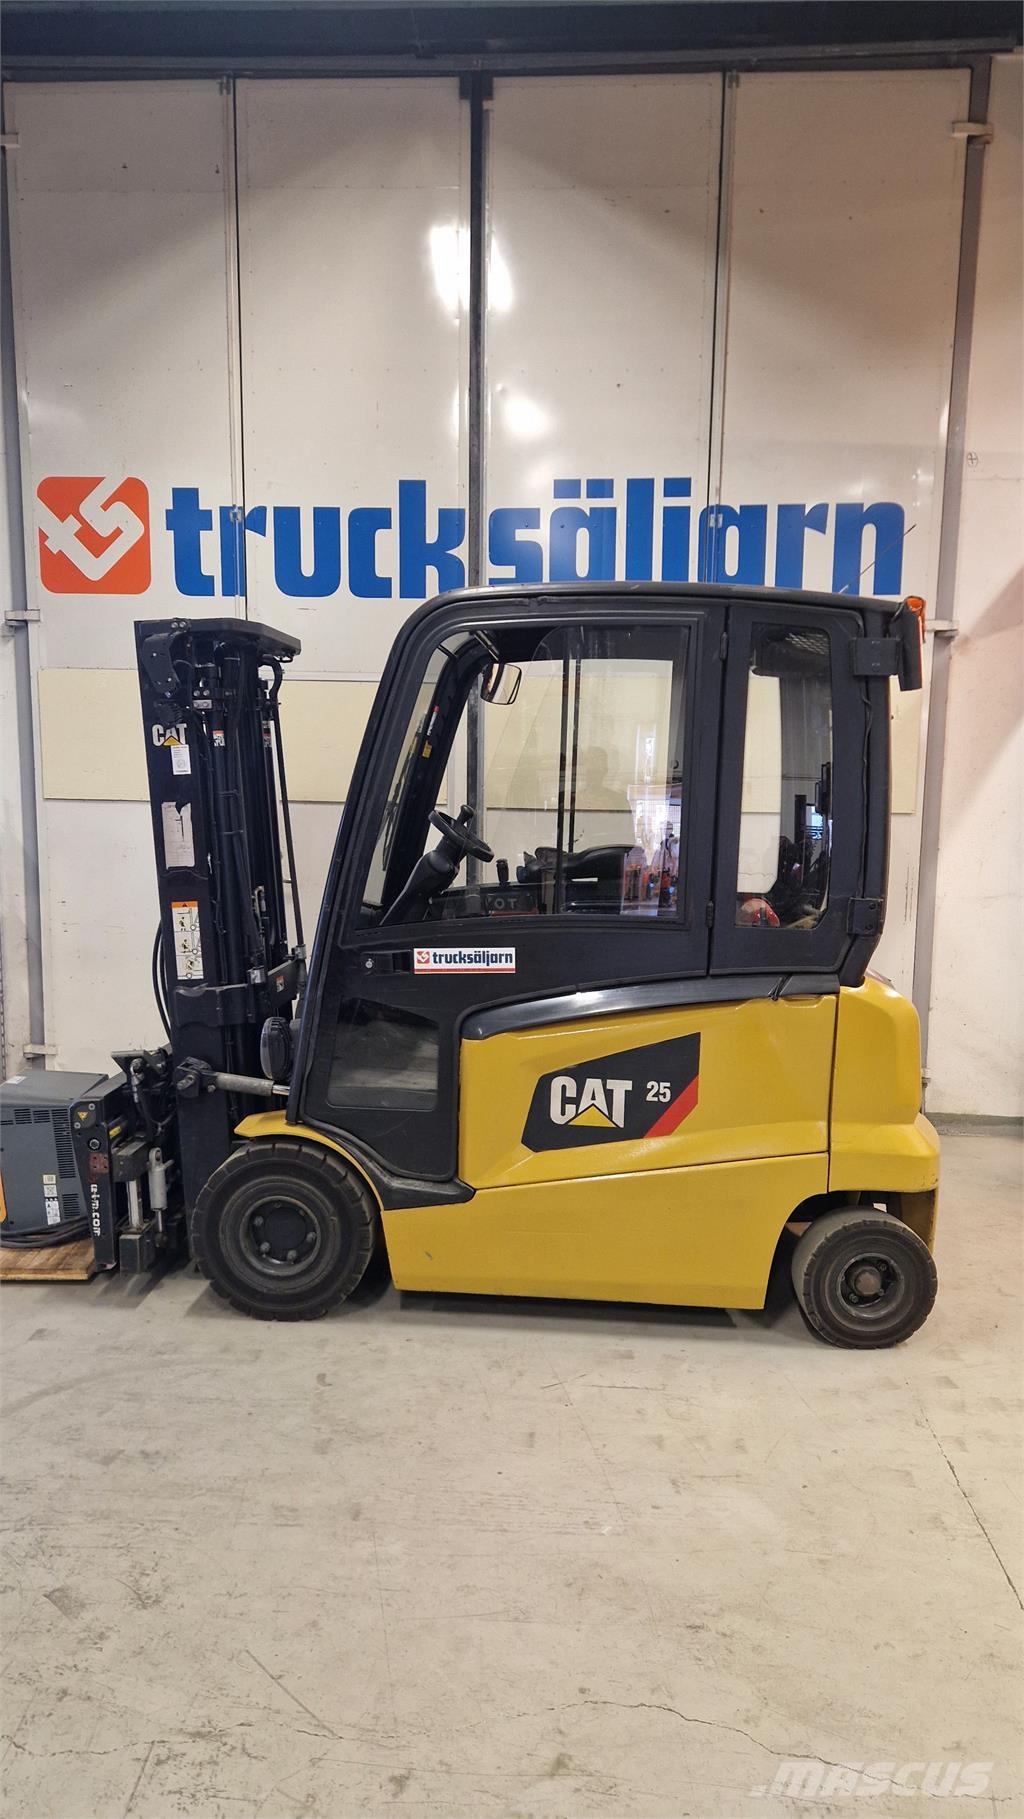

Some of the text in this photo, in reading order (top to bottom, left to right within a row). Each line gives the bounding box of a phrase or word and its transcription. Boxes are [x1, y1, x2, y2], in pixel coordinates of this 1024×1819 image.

[166, 477, 906, 599] trucksäljarn
[152, 722, 188, 747] CAT
[432, 950, 513, 966] trucksäljarn
[550, 1075, 671, 1129] CAT 25
